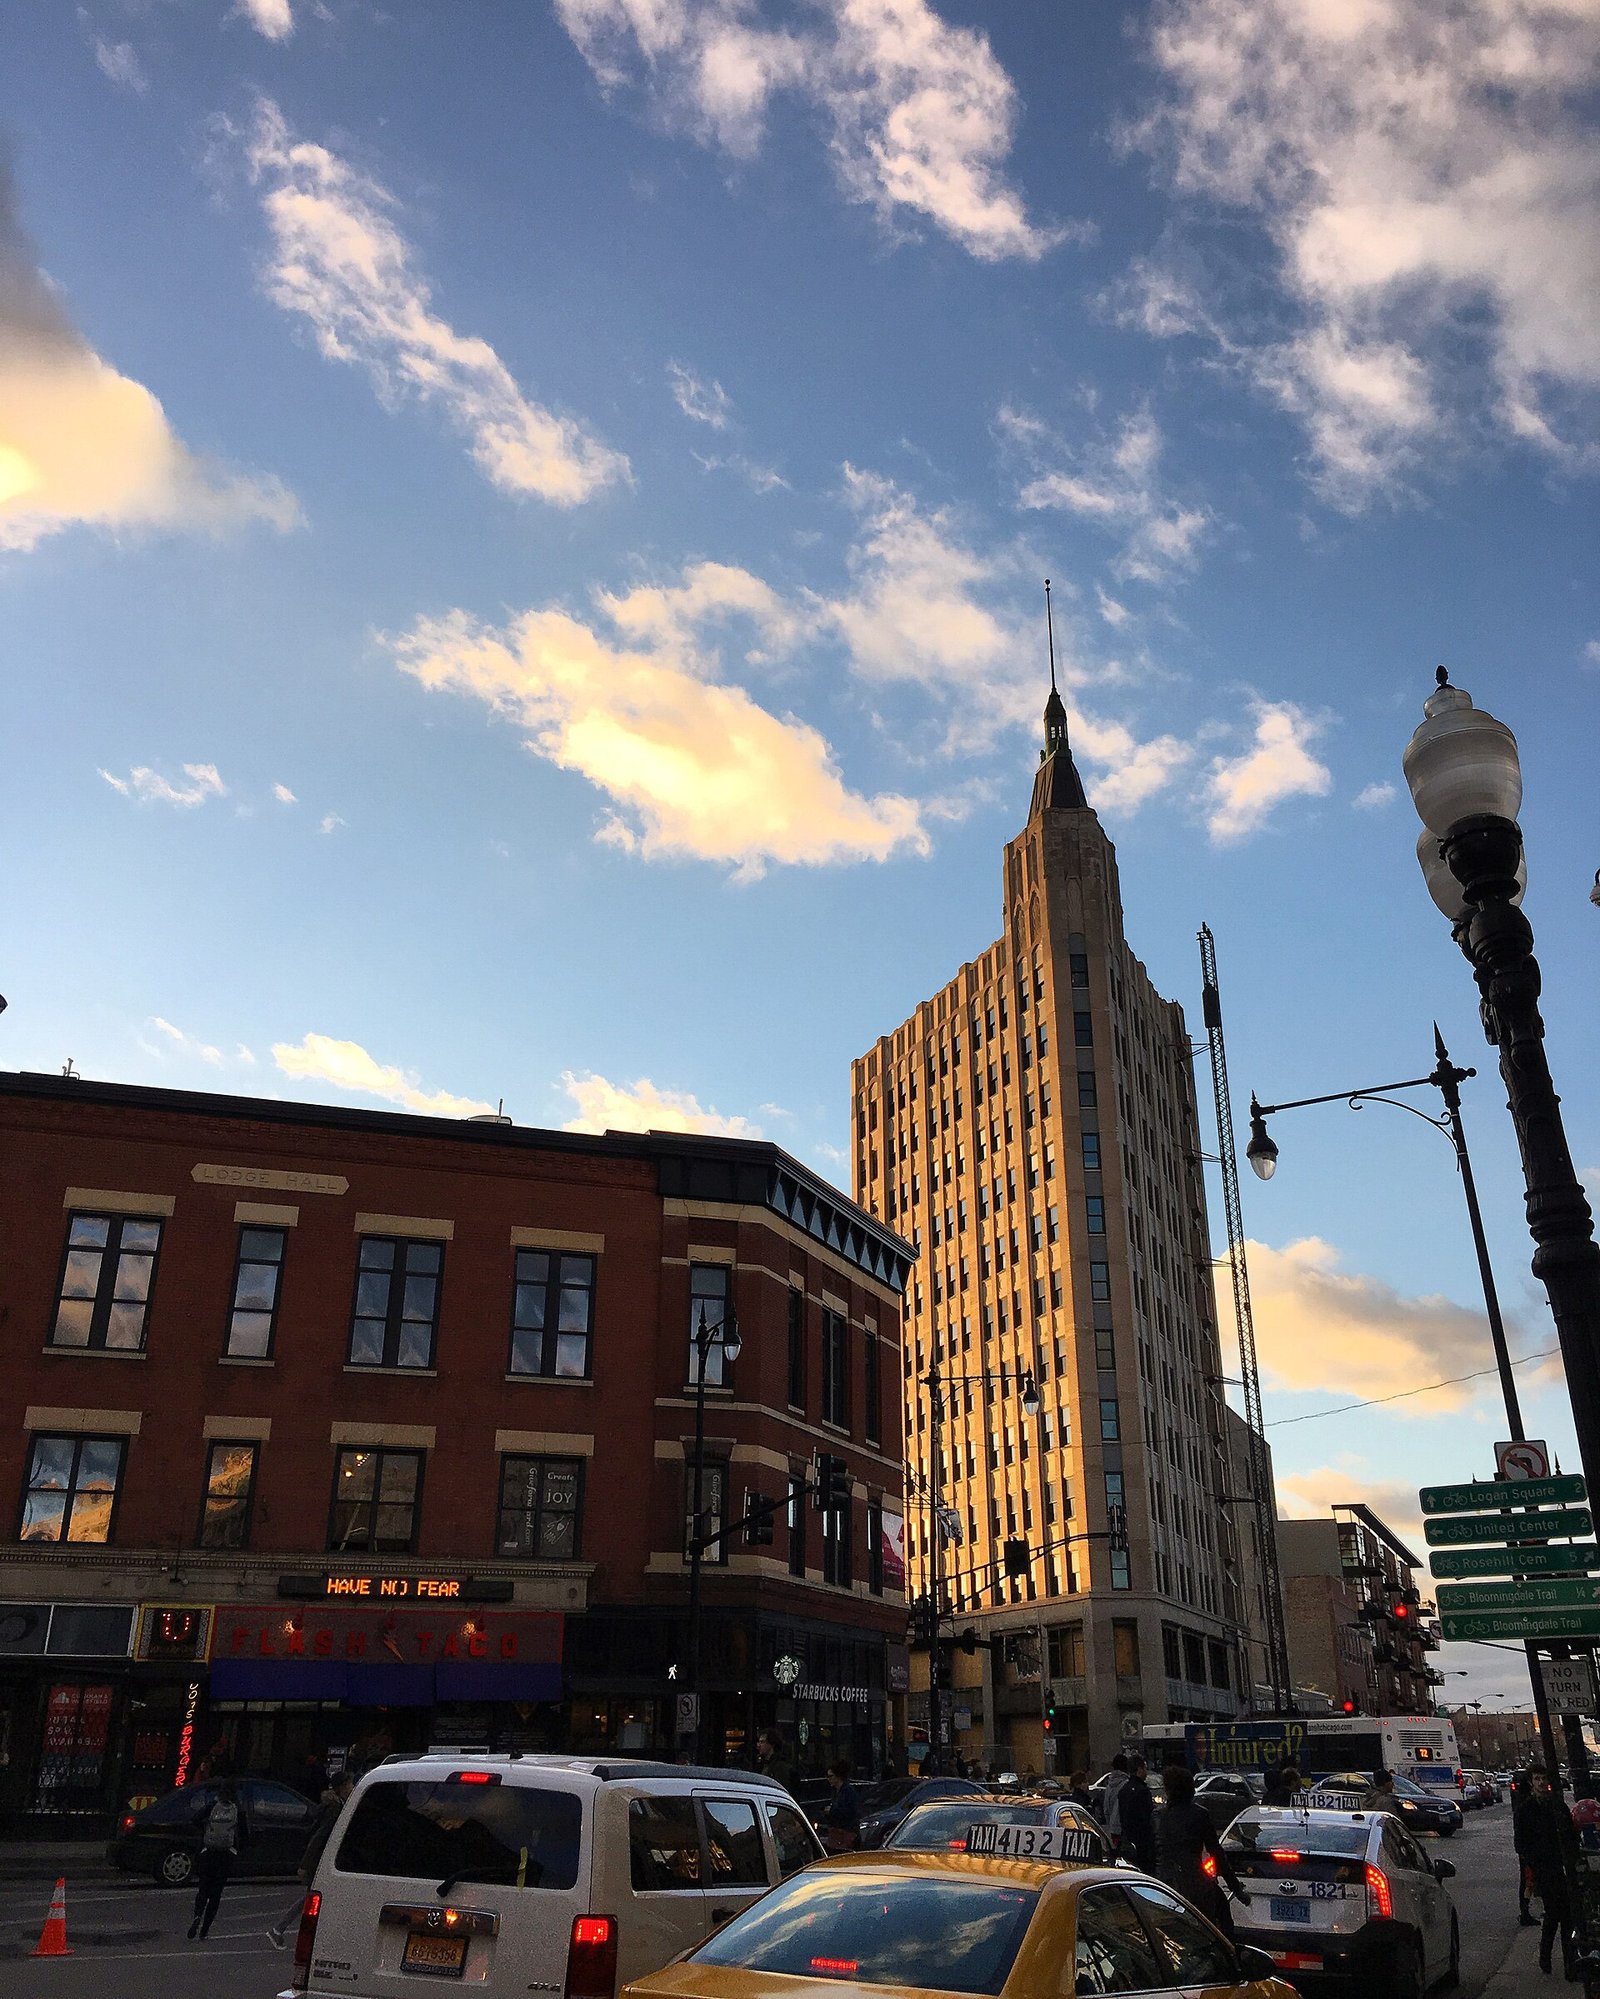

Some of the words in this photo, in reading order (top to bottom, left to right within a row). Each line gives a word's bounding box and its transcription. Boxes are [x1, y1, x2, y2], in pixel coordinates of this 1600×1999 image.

[203, 1167, 270, 1184] LODGE
[285, 1174, 338, 1190] HALL
[547, 1472, 575, 1481] Create
[1469, 1490, 1508, 1504] Logan
[1512, 1487, 1555, 1501] Square
[1574, 1482, 1582, 1494] 2
[1474, 1523, 1515, 1535] United
[1519, 1520, 1560, 1532] Center
[1580, 1517, 1589, 1528] 2
[1462, 1555, 1514, 1569] Rosehill
[1518, 1554, 1547, 1565] Cem
[1568, 1551, 1578, 1562] 5
[327, 1578, 371, 1595] HAVE
[417, 1580, 460, 1597] FEAR
[1469, 1589, 1535, 1604] Bloomingdale
[1536, 1588, 1558, 1600] Trail
[1492, 1618, 1559, 1633] Bloomingdale
[1560, 1617, 1582, 1629] Trail
[231, 1626, 367, 1657] FLASH
[416, 1630, 519, 1658] TACO
[1552, 1667, 1573, 1678] NO
[792, 1683, 839, 1702] STARBUCKS
[840, 1686, 868, 1703] COFFEE
[1549, 1682, 1581, 1692] TURN
[1567, 1697, 1590, 1708] RED
[1208, 1723, 1303, 1767] Injured?
[1419, 1748, 1429, 1758] 72
[1293, 1794, 1309, 1806] TAXI
[1310, 1794, 1342, 1809] 1821
[1344, 1797, 1359, 1809] TAXI
[970, 1826, 996, 1851] TAXI
[998, 1828, 1053, 1855] 4132
[1065, 1831, 1092, 1858] TAXI
[1308, 1882, 1346, 1899] 1821
